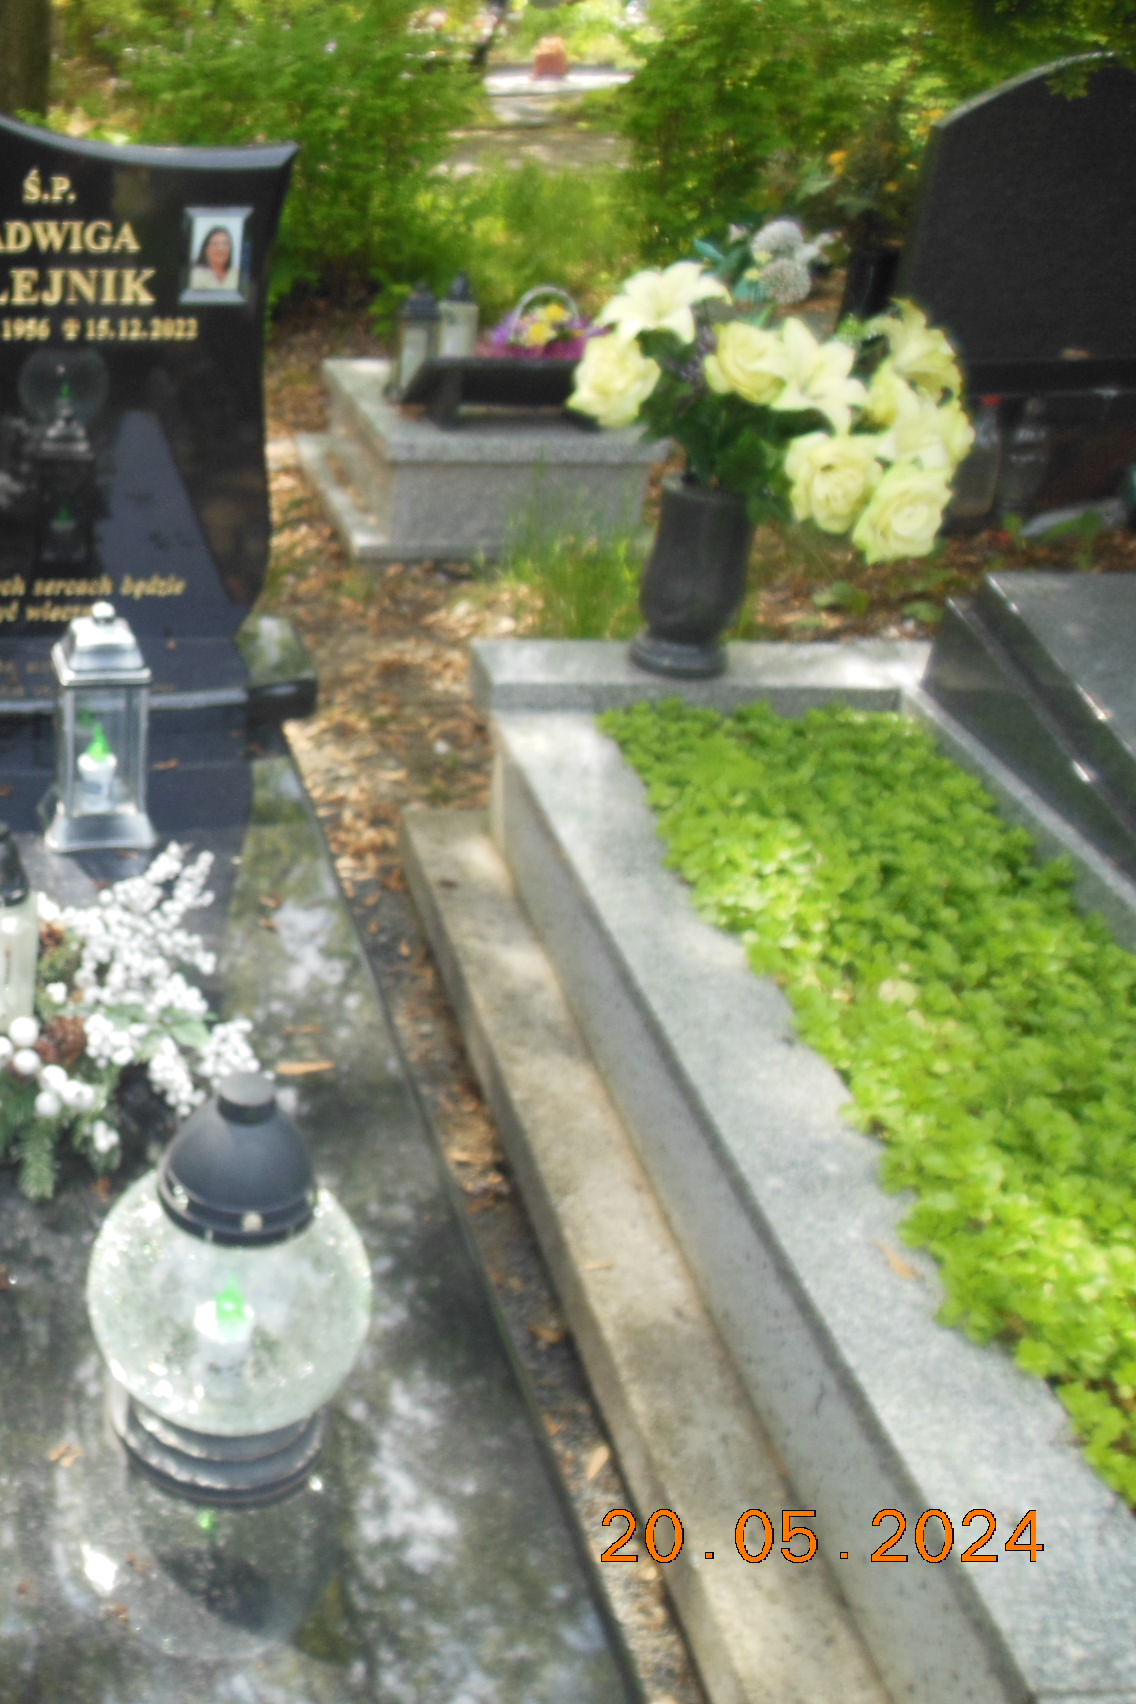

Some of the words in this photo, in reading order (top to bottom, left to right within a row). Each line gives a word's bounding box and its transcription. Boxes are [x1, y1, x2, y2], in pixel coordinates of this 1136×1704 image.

[23, 168, 77, 204] Ś.P.
[32, 574, 113, 596] sercach
[120, 574, 186, 600] będzie
